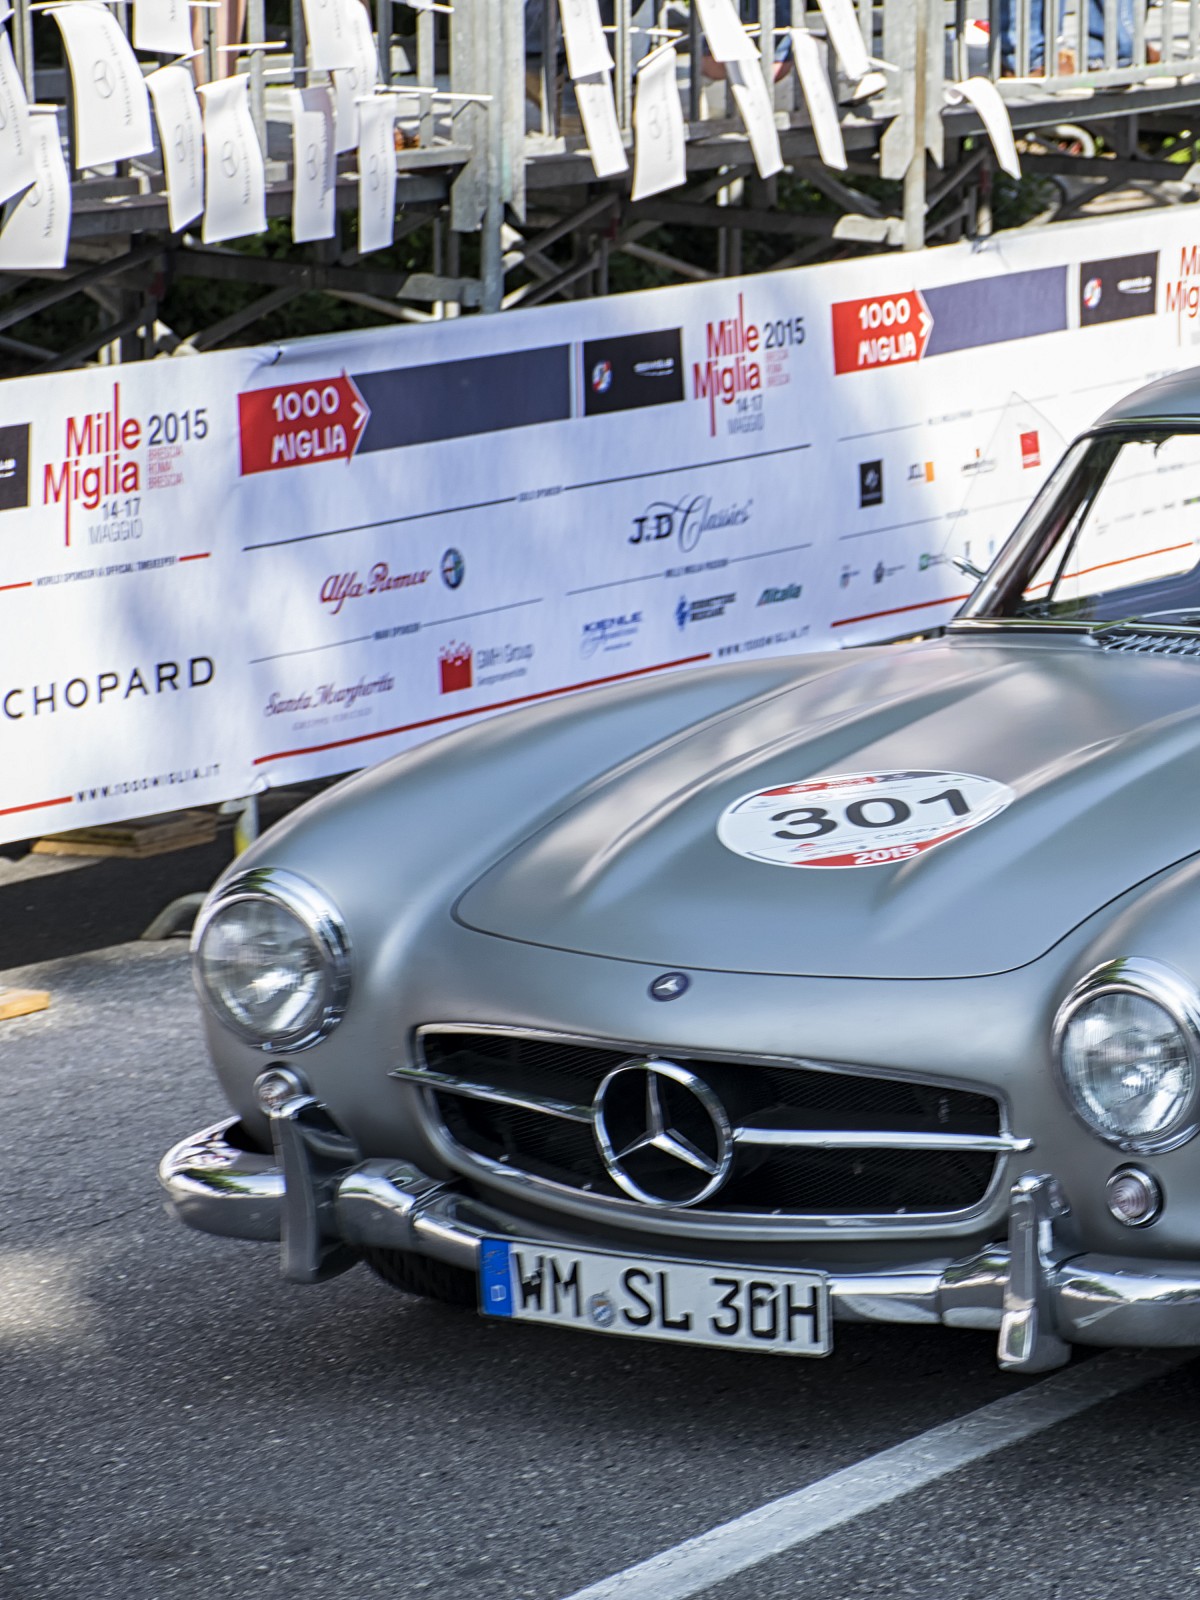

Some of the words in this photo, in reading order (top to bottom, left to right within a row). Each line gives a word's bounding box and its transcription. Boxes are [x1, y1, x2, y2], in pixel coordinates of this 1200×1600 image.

[706, 292, 760, 358] Mille
[764, 317, 805, 348] 2015
[858, 298, 911, 330] 1000
[858, 331, 917, 365] MIGLIA
[271, 386, 339, 422] 1000
[693, 355, 762, 437] Miglia
[66, 382, 142, 458] Mille
[147, 408, 209, 446] 2015
[270, 424, 346, 464] MIGLIA
[43, 453, 141, 546] Miglia
[101, 498, 141, 520] 14-17
[88, 518, 144, 544] MAGGIO
[319, 571, 364, 615] Alfa
[2, 656, 217, 720] CHOPARD
[770, 788, 972, 840] 301
[853, 844, 921, 865] 2015
[514, 1251, 583, 1318] WM
[620, 1267, 691, 1331] SL
